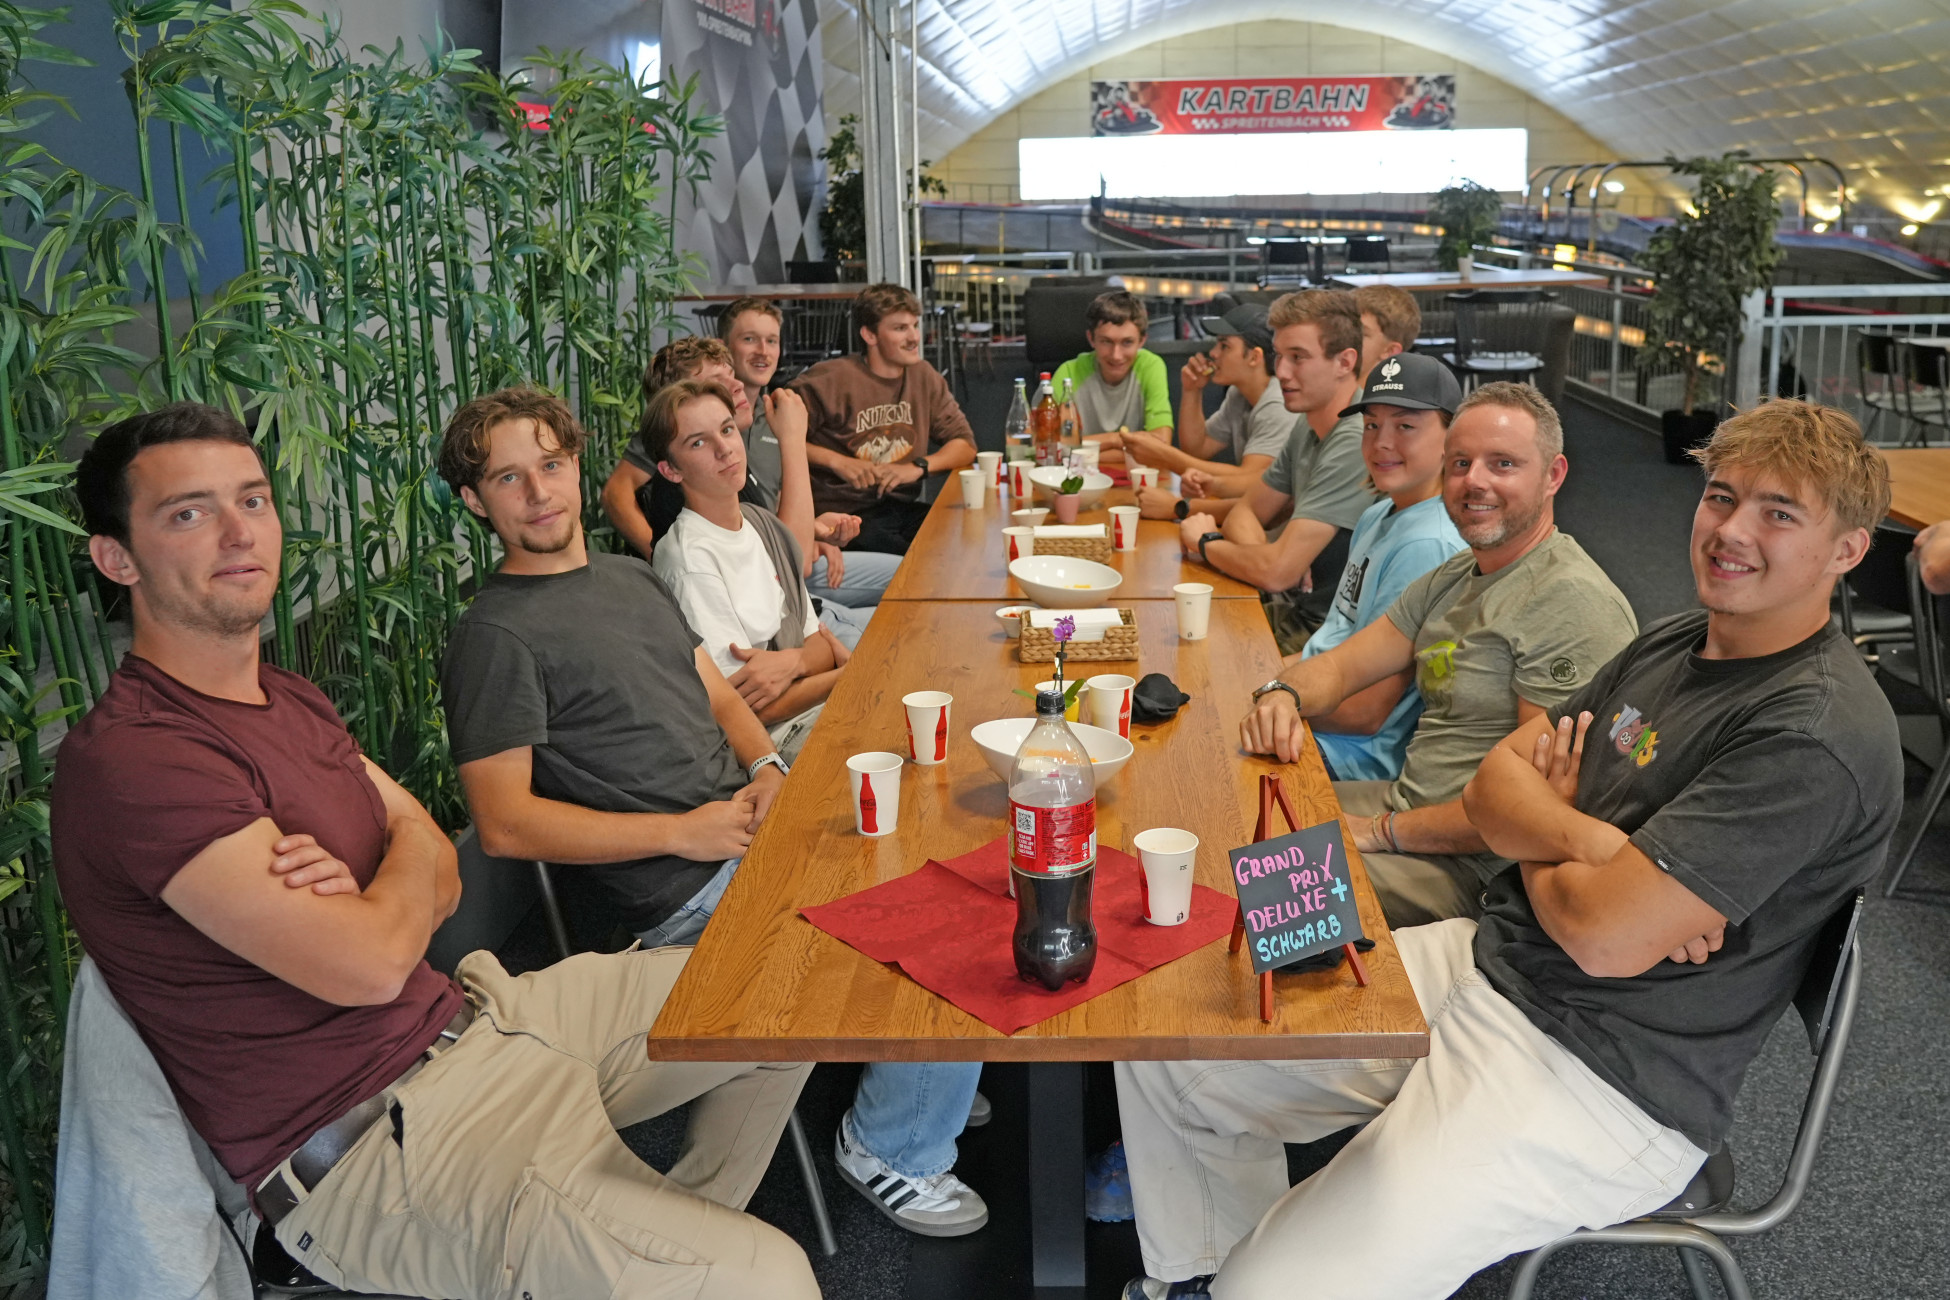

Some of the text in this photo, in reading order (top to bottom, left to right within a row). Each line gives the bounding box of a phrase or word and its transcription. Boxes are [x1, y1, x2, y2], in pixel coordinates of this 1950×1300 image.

[1177, 85, 1369, 114] KARTBAHN
[1372, 382, 1404, 392] STRAUSS
[1235, 846, 1305, 886] GRAND
[1246, 887, 1328, 933] DELUXE
[1256, 914, 1342, 963] SCHWARB
